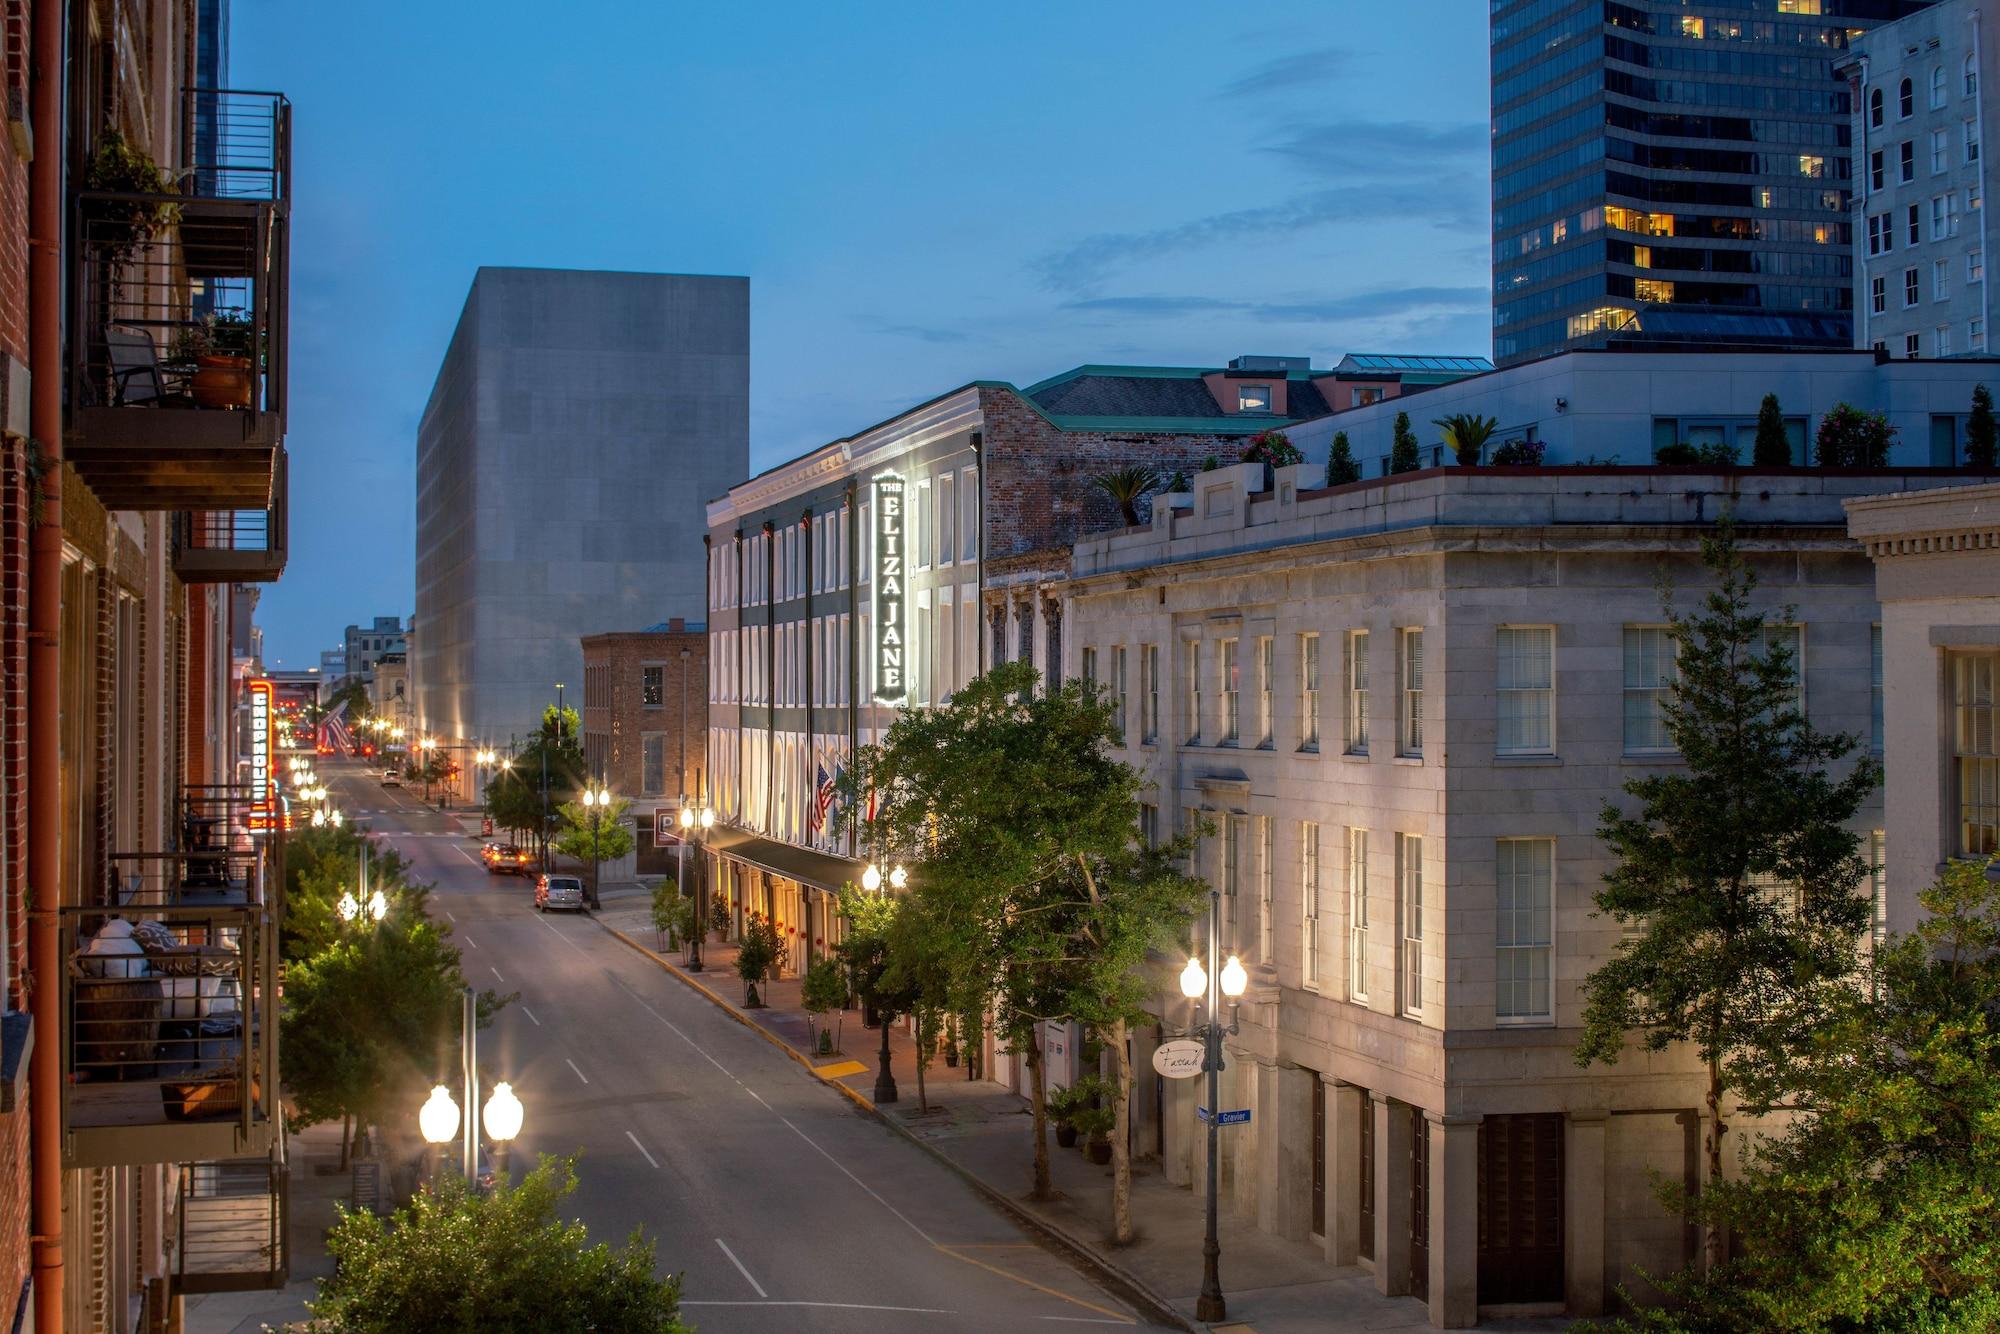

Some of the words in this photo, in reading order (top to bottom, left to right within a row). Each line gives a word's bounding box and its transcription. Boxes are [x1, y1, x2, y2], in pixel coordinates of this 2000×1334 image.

[880, 483, 902, 492] THE
[883, 497, 900, 594] ELIZA
[883, 602, 901, 687] JANE
[662, 817, 673, 830] P
[1223, 1111, 1245, 1122] Gravier
